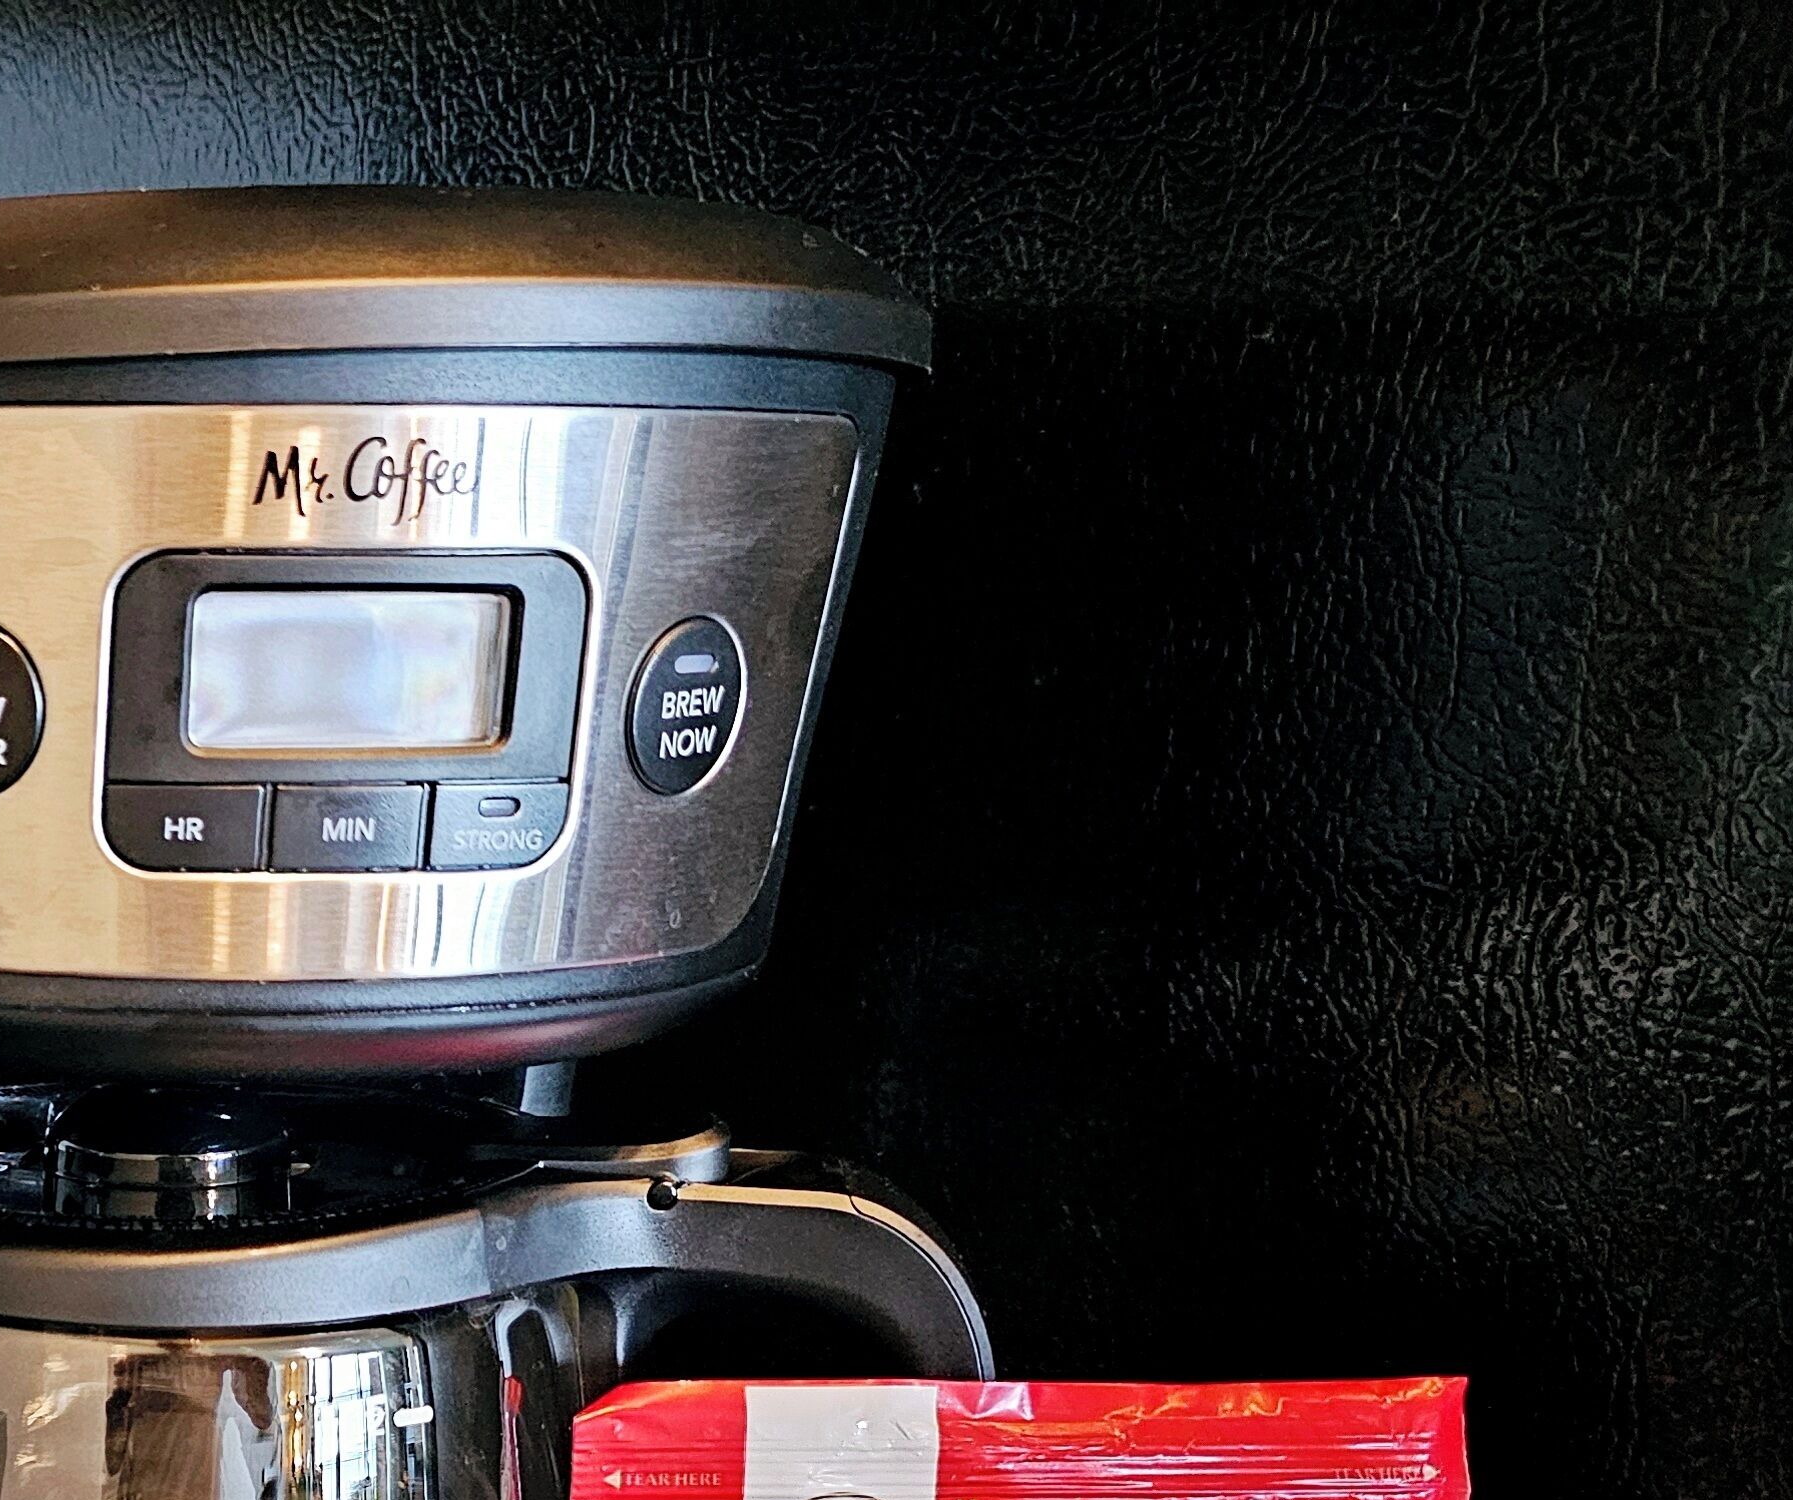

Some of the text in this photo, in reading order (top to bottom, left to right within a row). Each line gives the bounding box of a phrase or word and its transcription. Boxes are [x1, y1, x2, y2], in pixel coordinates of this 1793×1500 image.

[252, 436, 479, 527] Mr. Coffee
[661, 684, 726, 720] BREW
[659, 724, 718, 760] NOW
[163, 816, 205, 843] HR
[321, 816, 377, 843] MIN
[452, 828, 544, 851] STRONG
[624, 1471, 722, 1487] TEAR HERE
